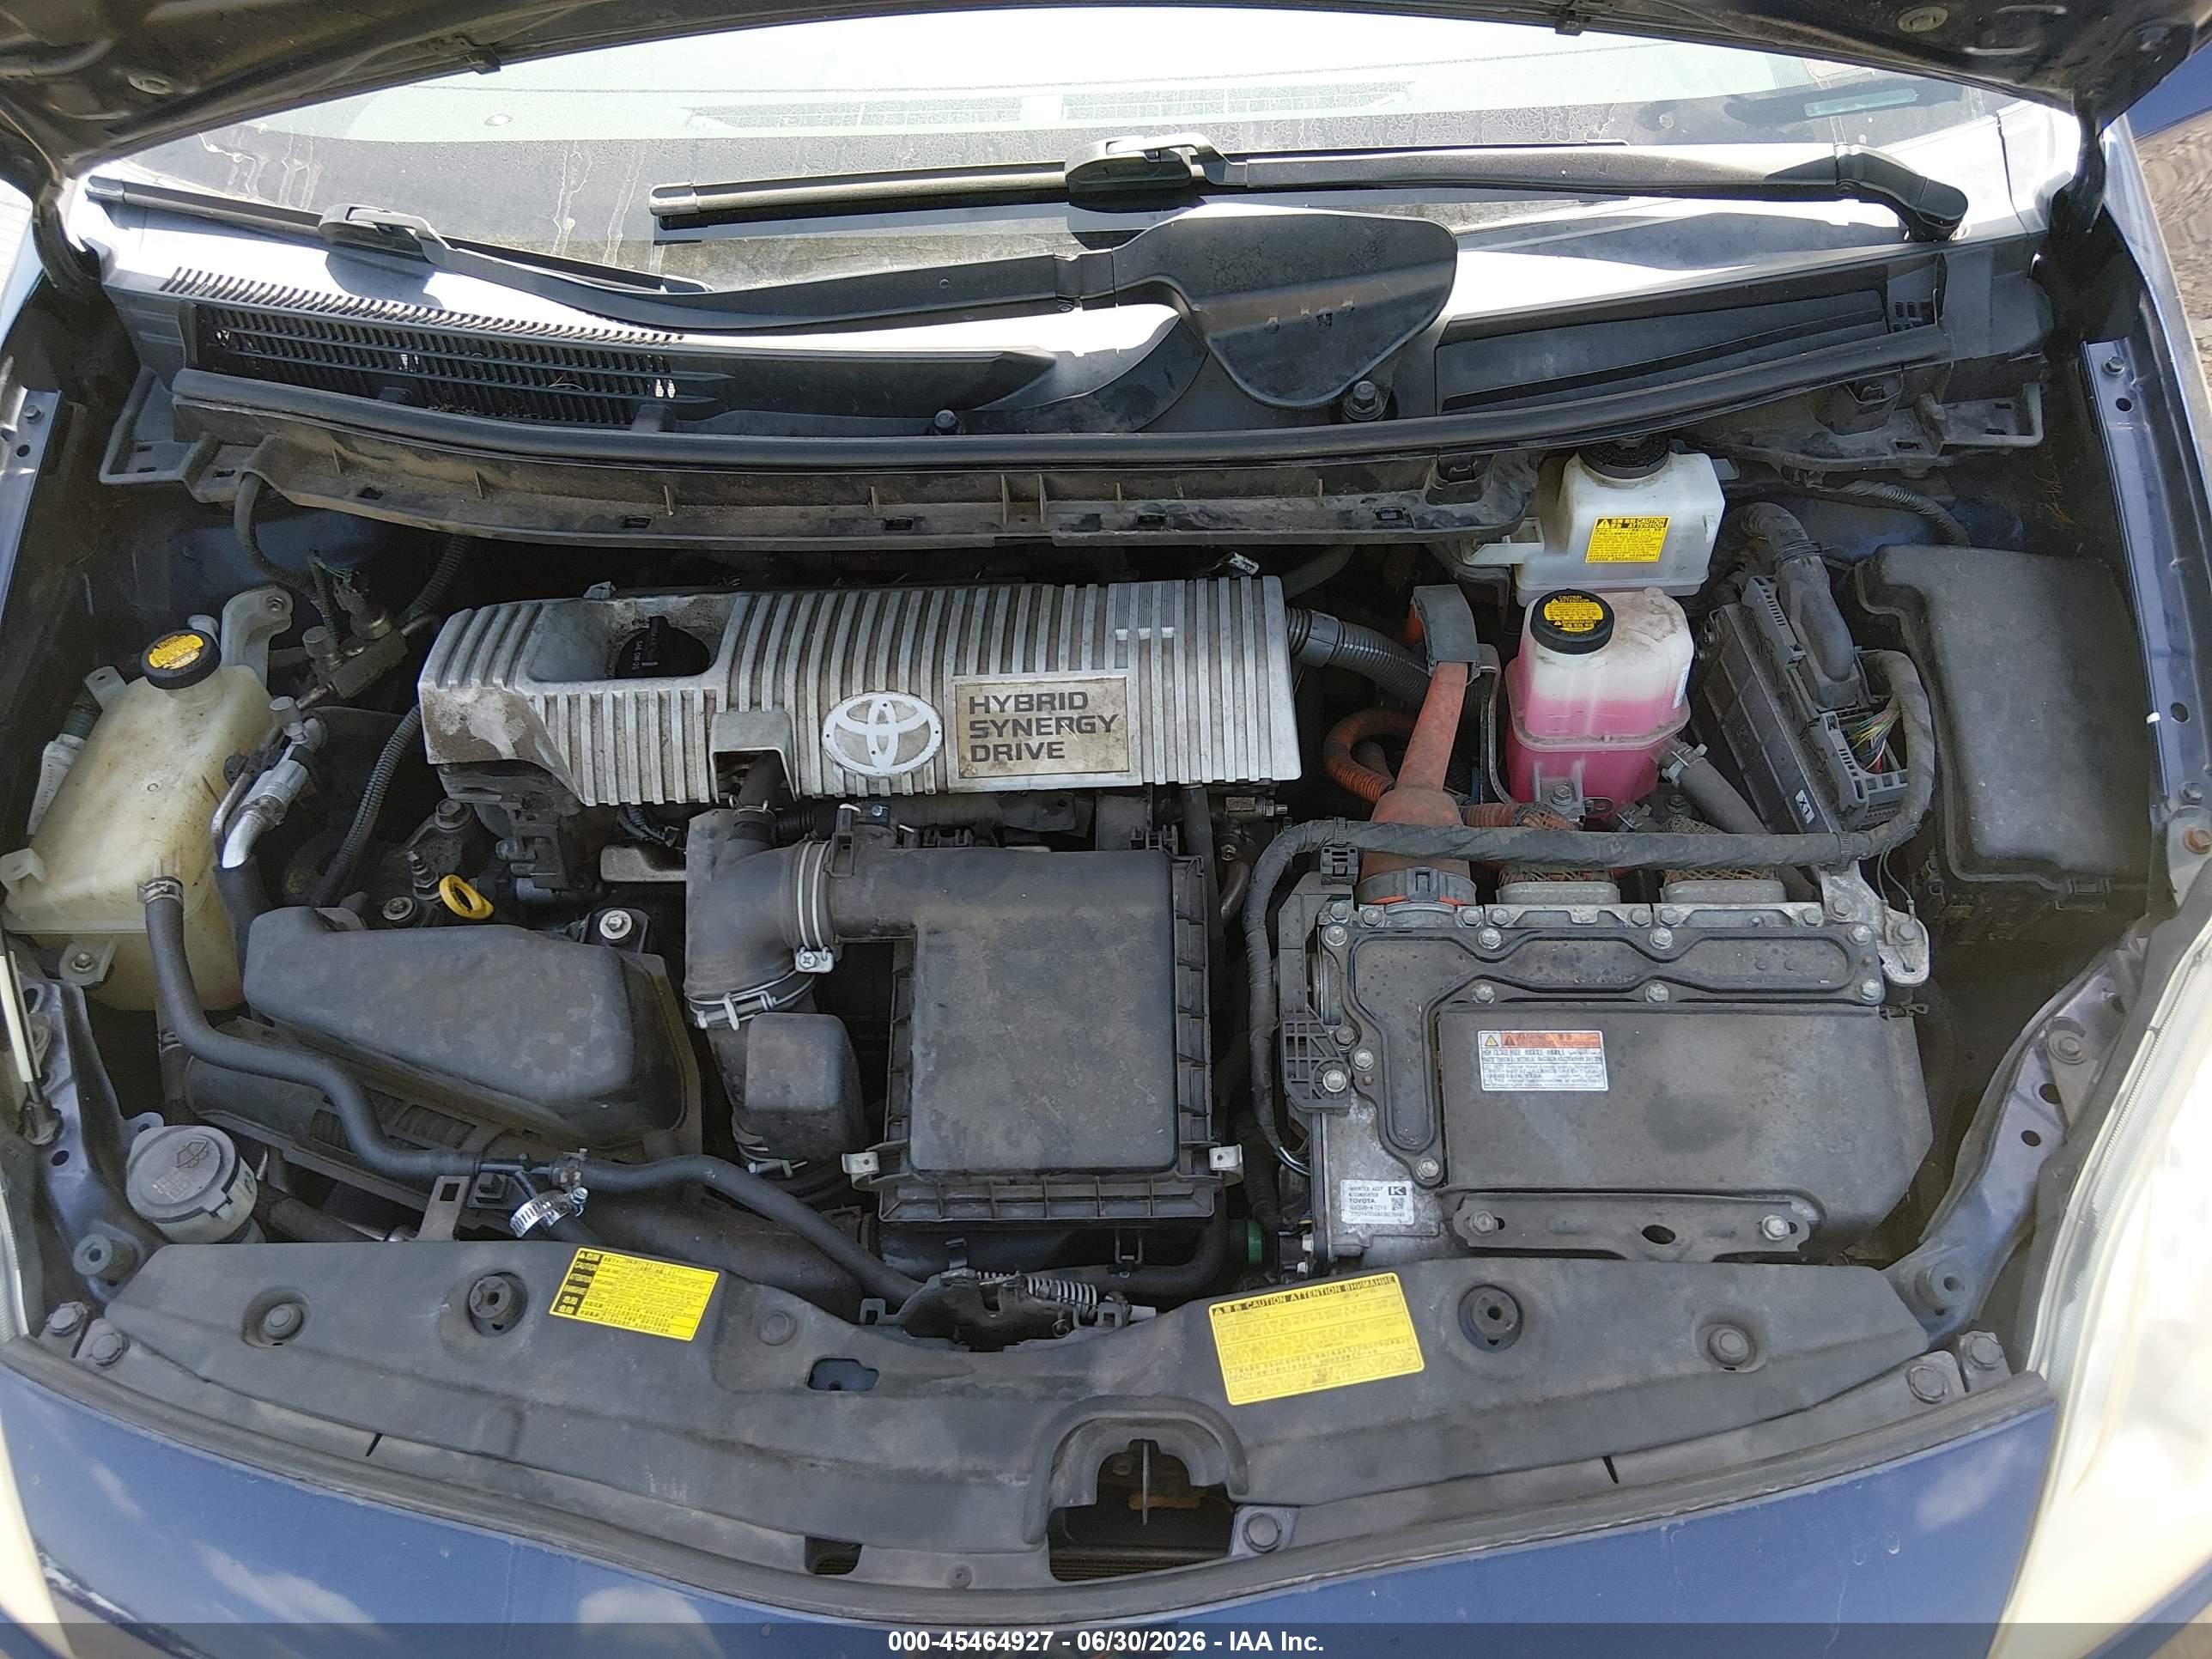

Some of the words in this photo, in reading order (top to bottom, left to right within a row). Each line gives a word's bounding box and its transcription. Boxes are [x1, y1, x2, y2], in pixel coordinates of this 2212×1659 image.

[969, 691, 1089, 714] HYBRID
[969, 714, 1119, 738] SYNERGY
[970, 741, 1066, 763] DRIVE
[1799, 797, 1809, 815] X1
[1345, 1276, 1395, 1292] ВНИМАНИЕ
[1246, 1295, 1286, 1310] CAUTION
[1291, 1285, 1341, 1302] ATTENTION
